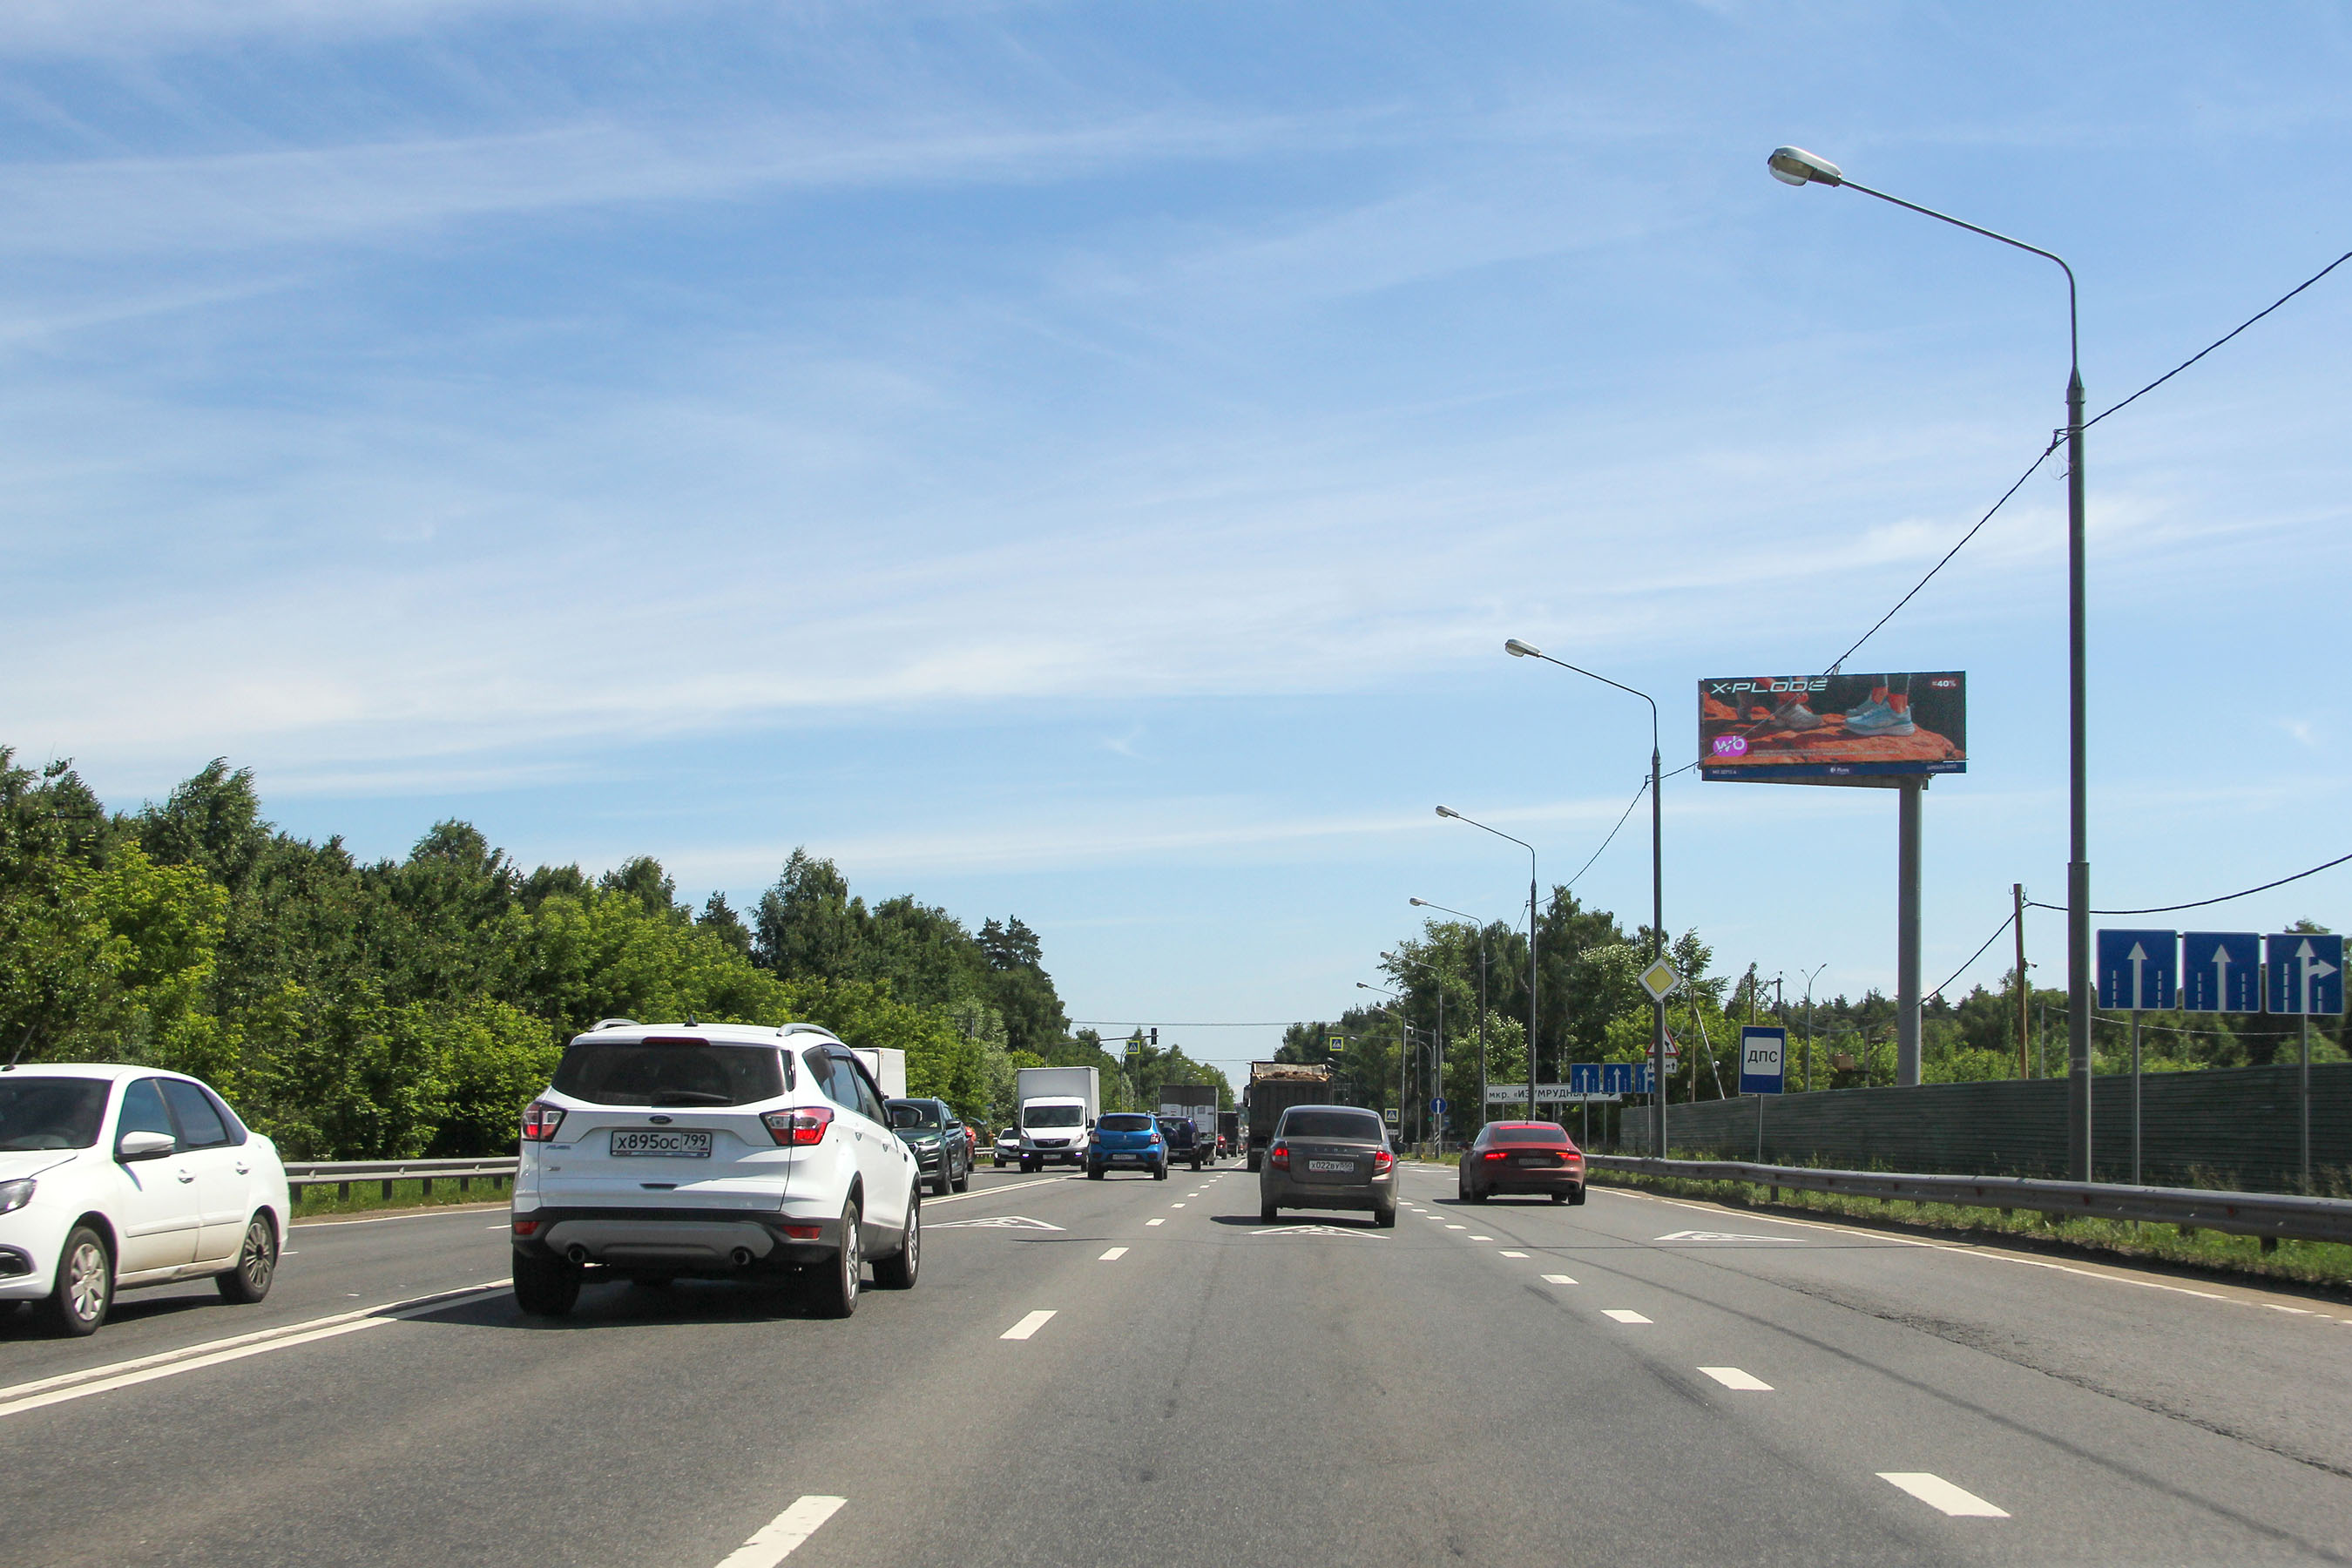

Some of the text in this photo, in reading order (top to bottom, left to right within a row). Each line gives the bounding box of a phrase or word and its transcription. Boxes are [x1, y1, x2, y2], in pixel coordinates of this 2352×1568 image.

[1711, 679, 1828, 694] X-PLODE
[1747, 1050, 1778, 1064] ДПС
[1488, 1088, 1593, 1100] мкр. «ИЗМРУДН»
[683, 1133, 707, 1146] 799
